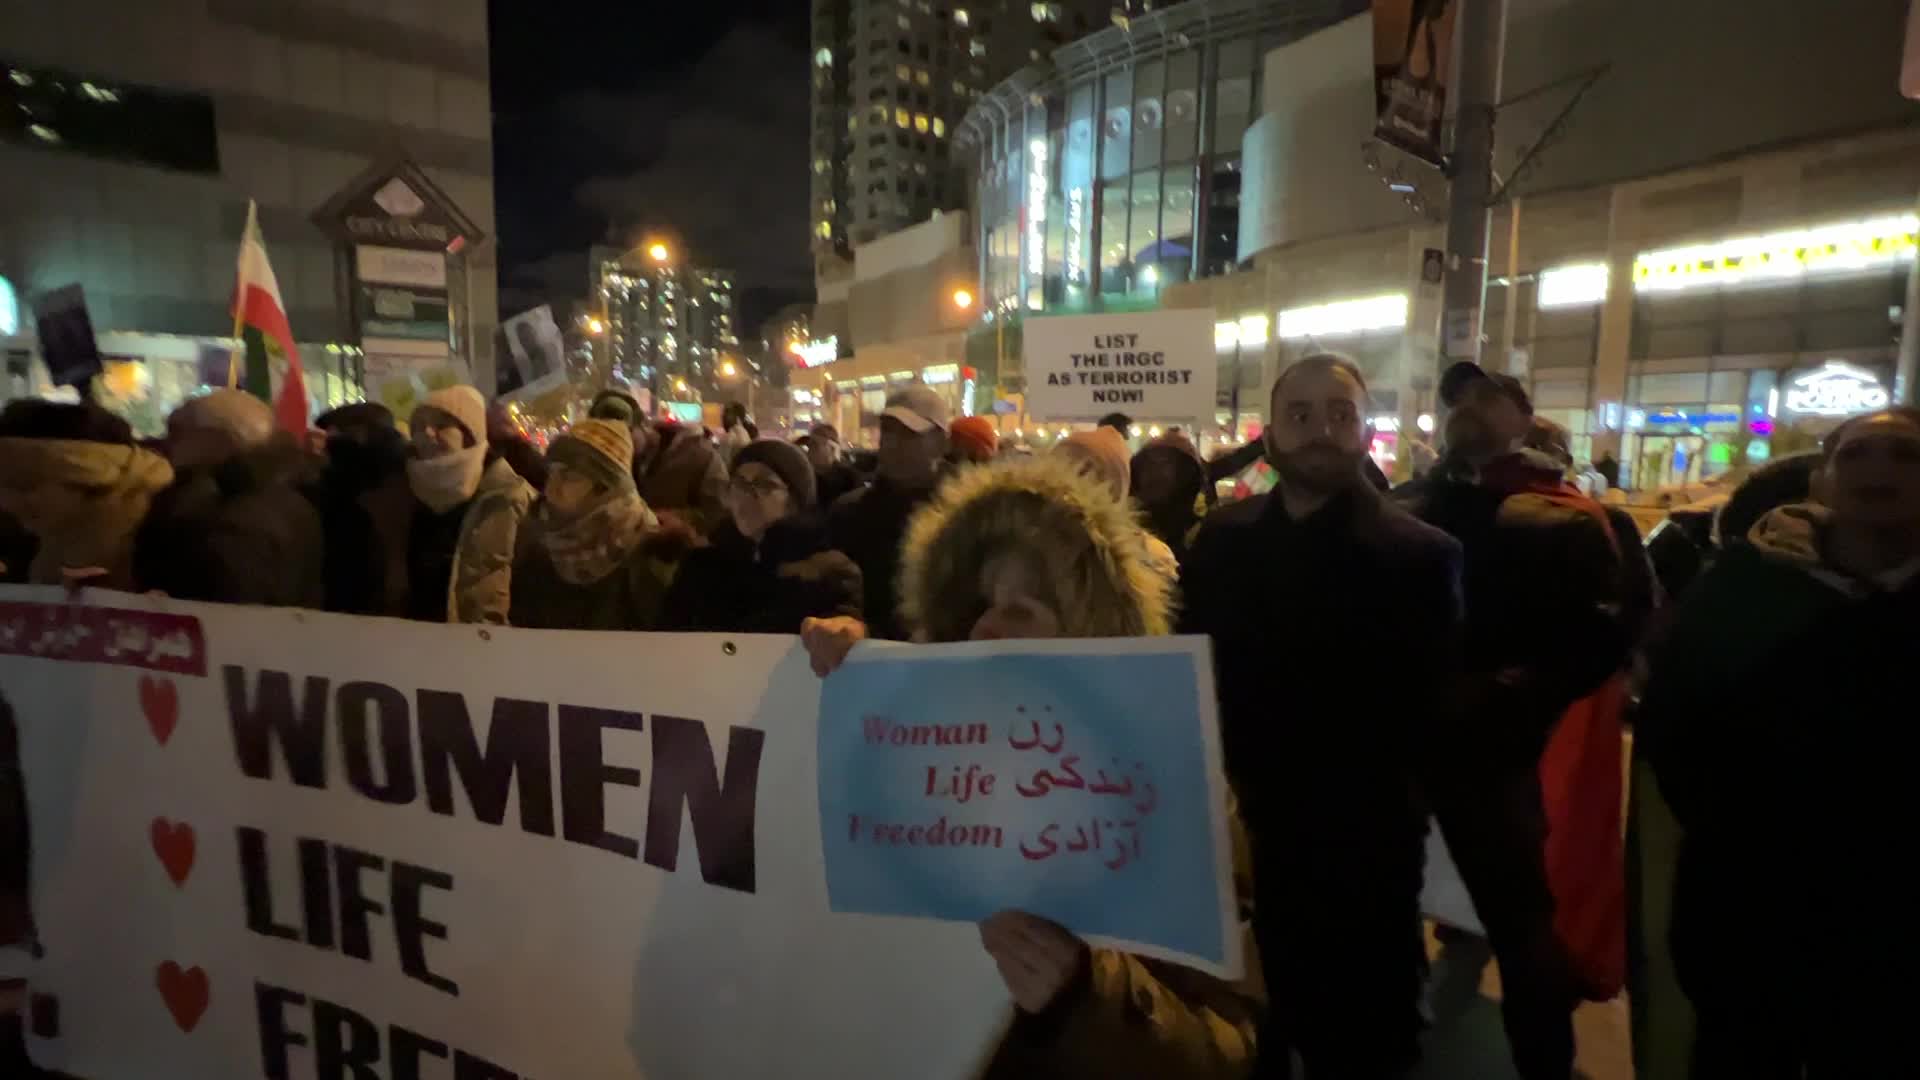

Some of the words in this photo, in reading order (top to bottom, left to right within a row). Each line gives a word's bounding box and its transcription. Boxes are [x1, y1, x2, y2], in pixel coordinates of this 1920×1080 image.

[1094, 334, 1138, 349] LIST
[1070, 354, 1109, 368] THE
[1116, 352, 1165, 367] IRGC
[1048, 373, 1072, 386] AS
[1077, 370, 1192, 386] TERRORIST
[1093, 389, 1144, 403] NOW!
[862, 714, 988, 747] Woman
[1008, 704, 1065, 754] زن
[222, 665, 766, 895] WOMEN
[925, 766, 997, 804] Life
[848, 815, 1004, 849] Freedom
[236, 826, 460, 997] LIFE
